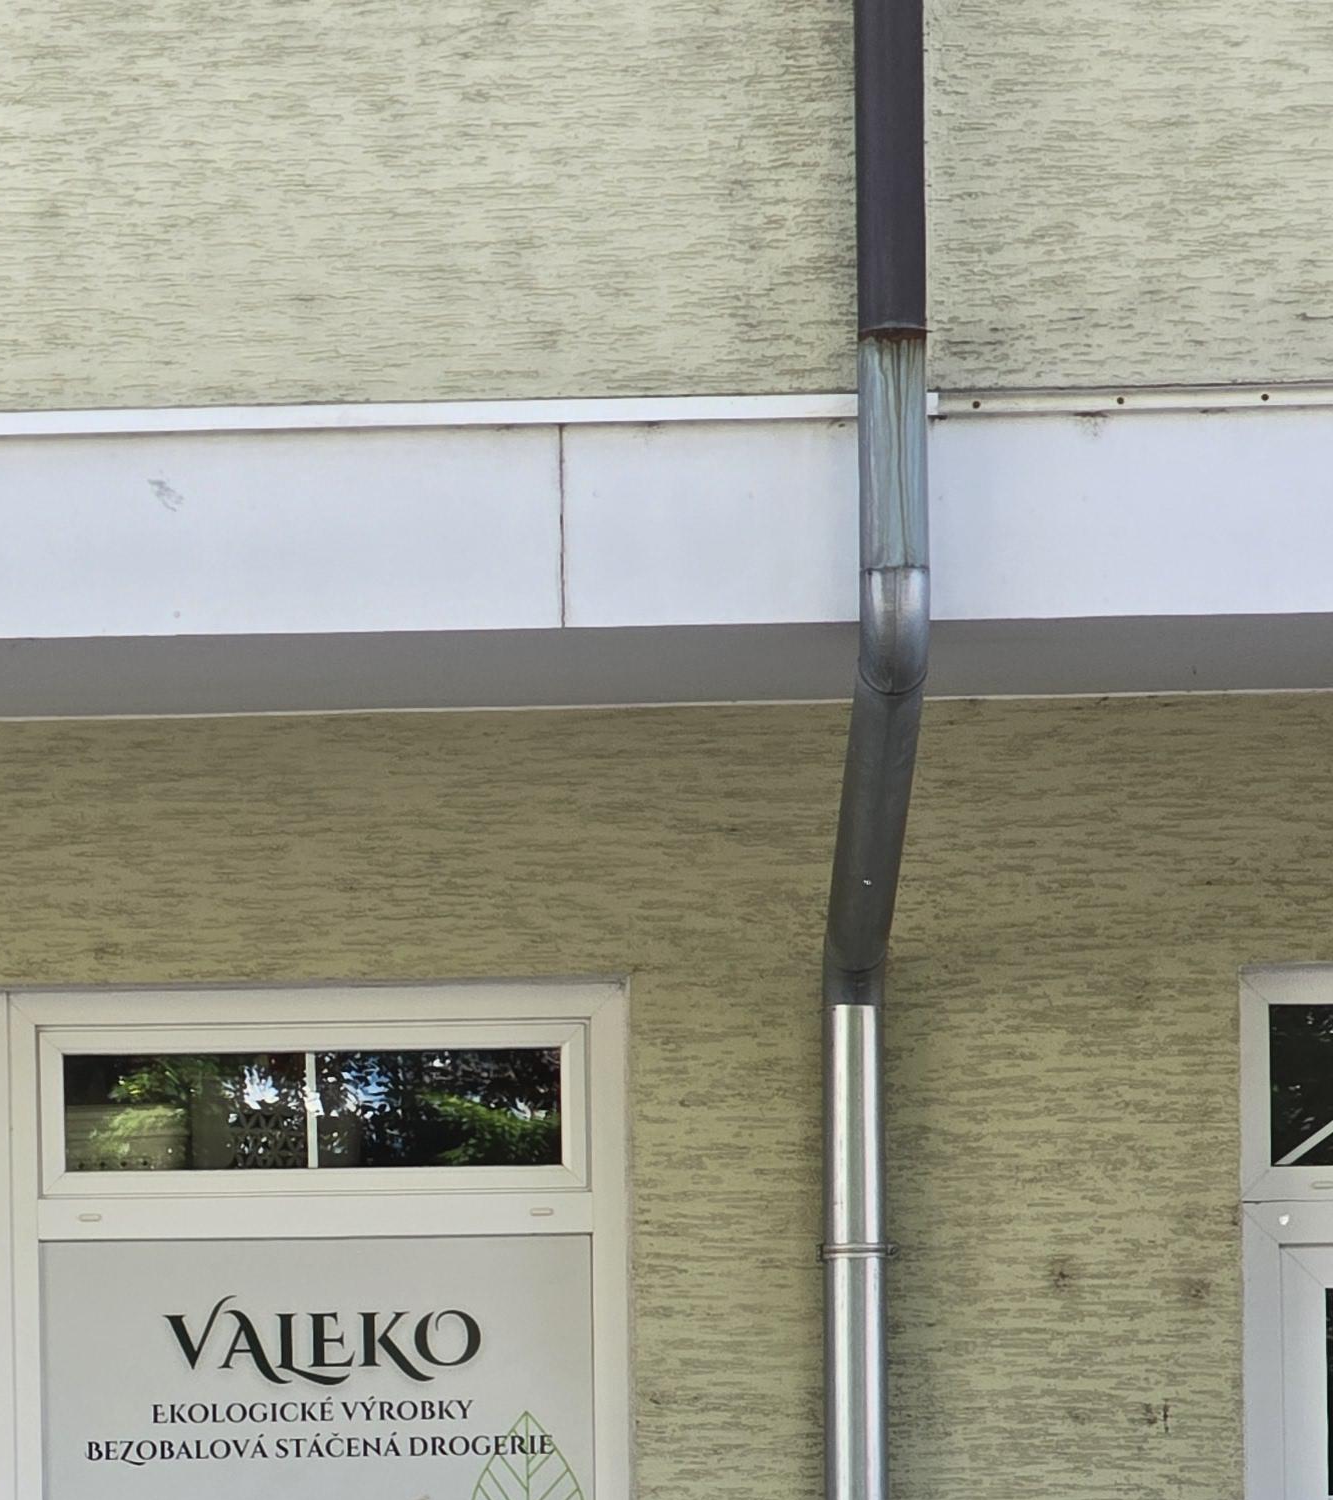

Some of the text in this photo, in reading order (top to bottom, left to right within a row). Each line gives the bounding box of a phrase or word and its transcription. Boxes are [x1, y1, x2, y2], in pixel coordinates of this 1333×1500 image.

[162, 1295, 482, 1386] VALEKO
[151, 1396, 475, 1425] EKOLOGICKÉ VÝROBKY
[86, 1431, 555, 1466] BEZOBALOVÁ STÁČENÁ DROGERIE
